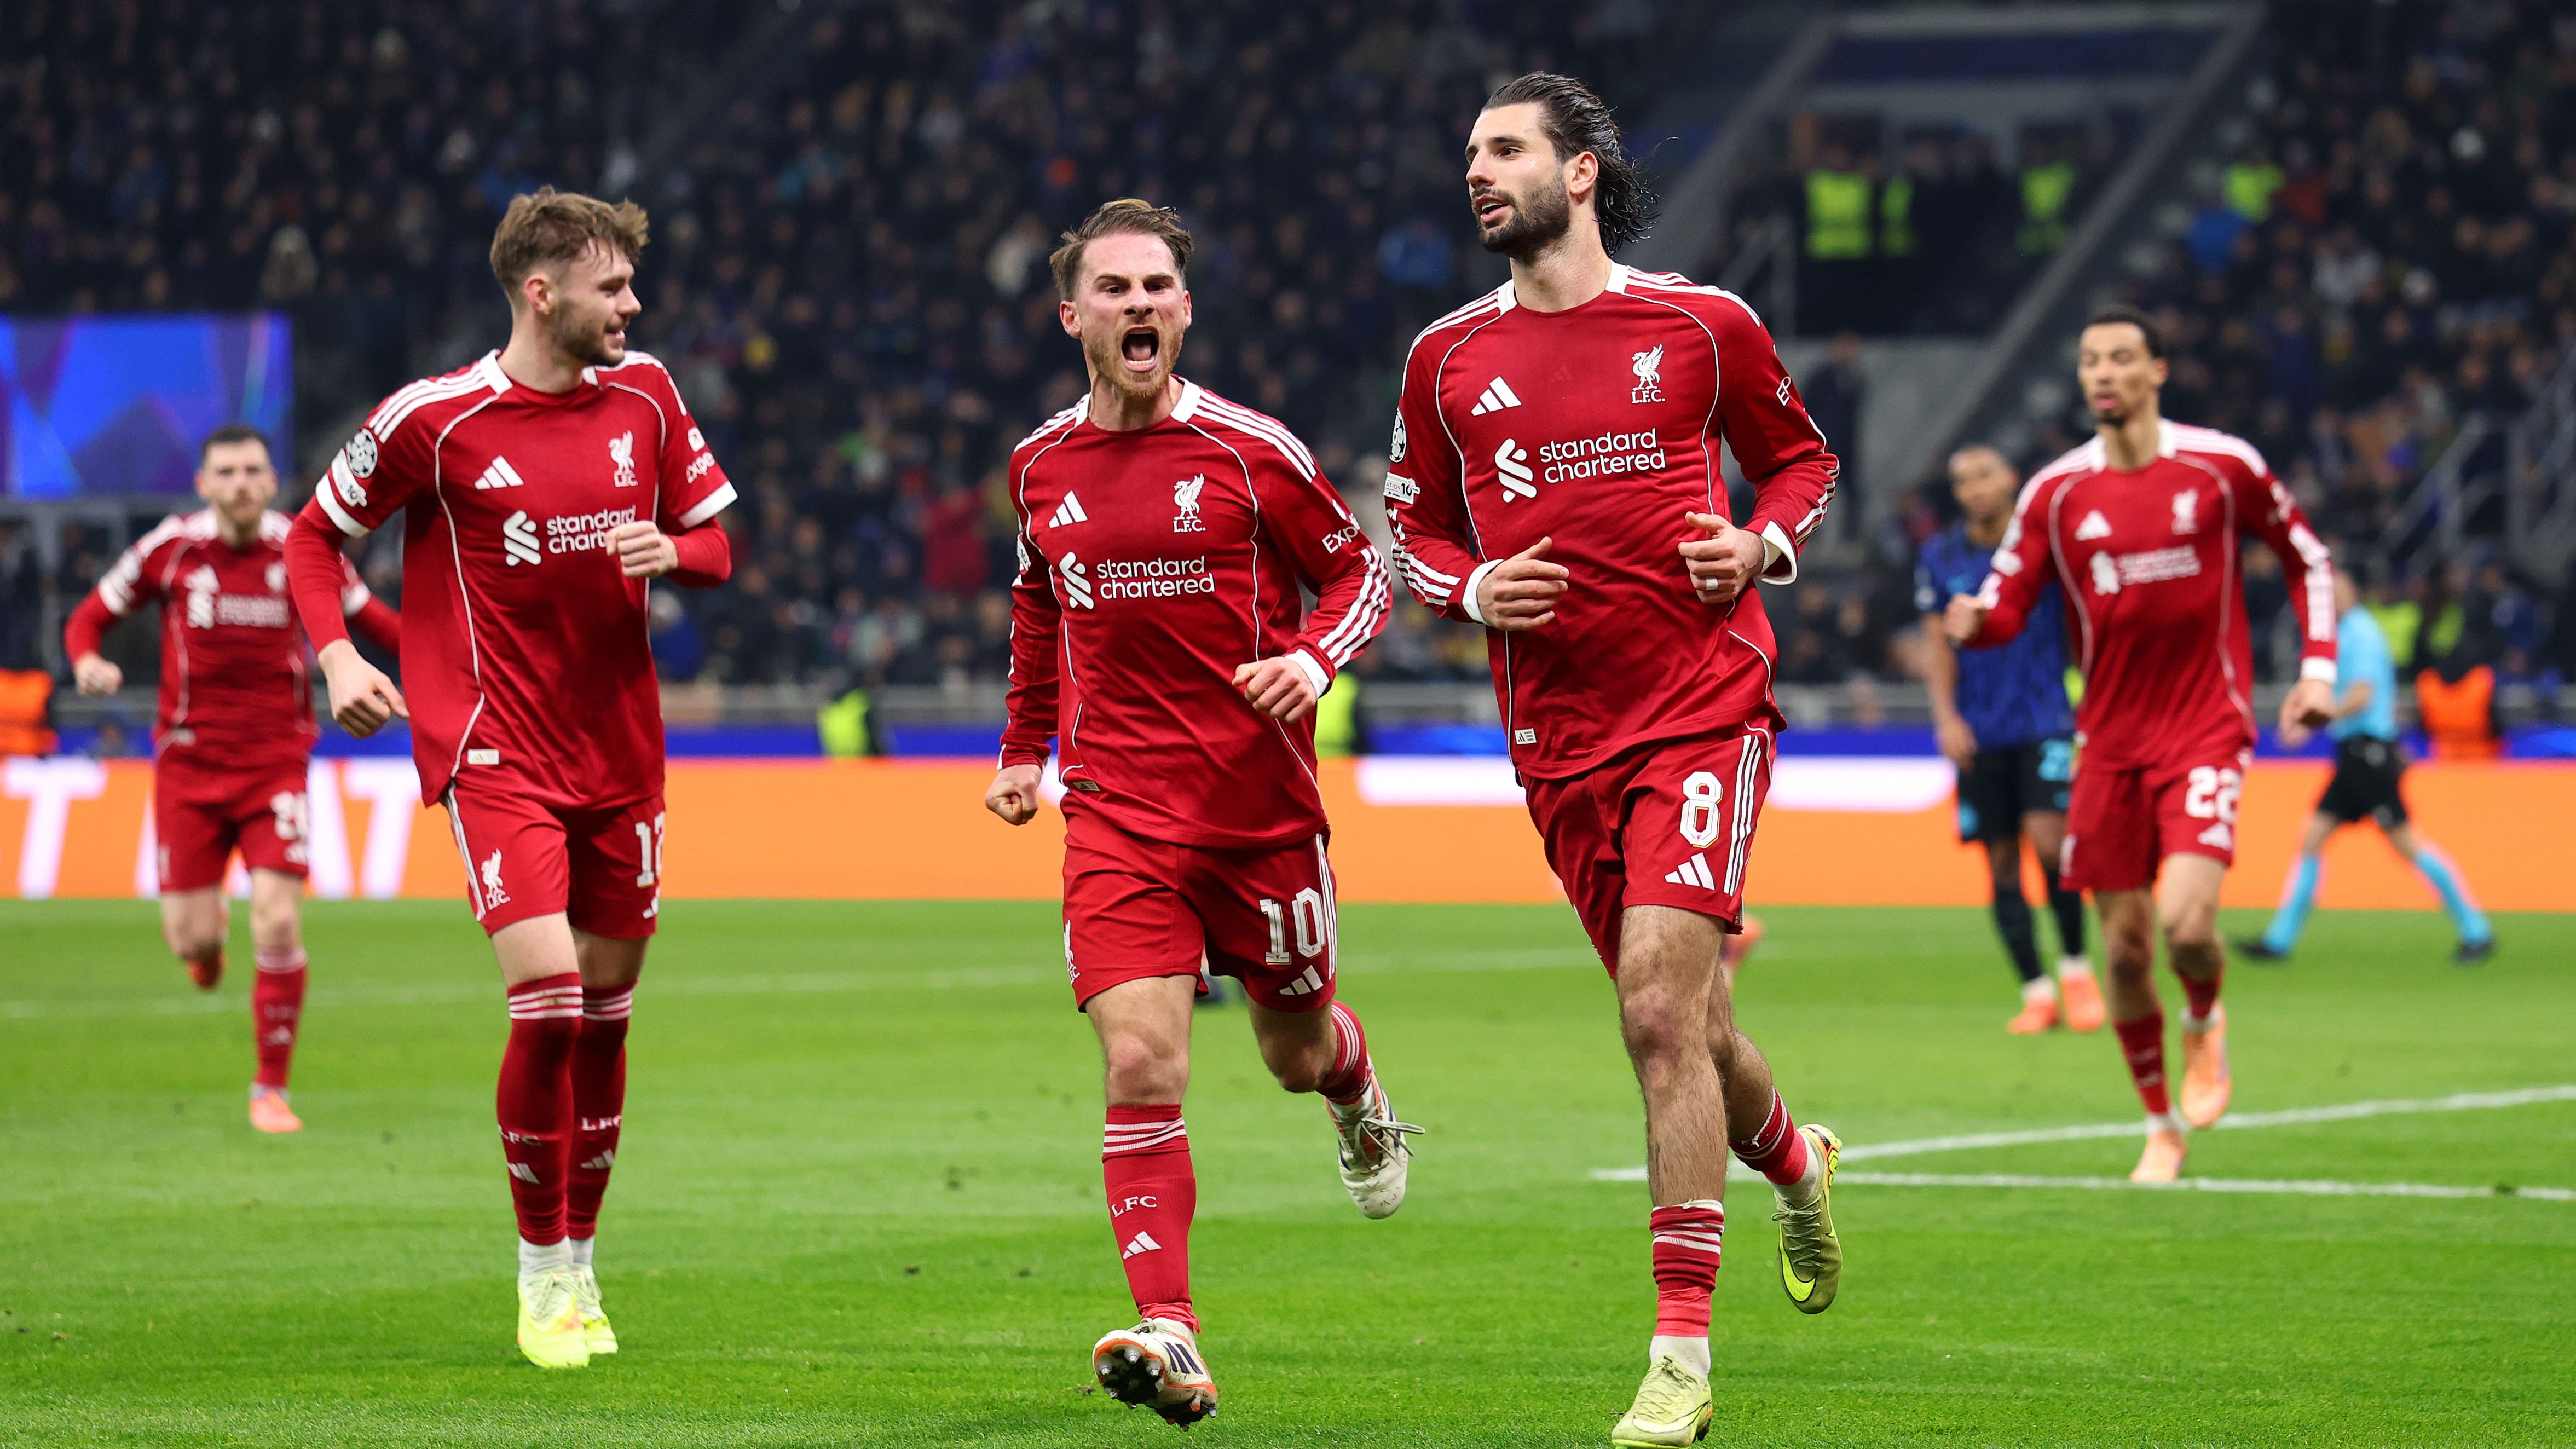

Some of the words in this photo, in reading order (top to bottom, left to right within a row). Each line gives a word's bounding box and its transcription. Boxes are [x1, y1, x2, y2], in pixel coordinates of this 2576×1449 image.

[1631, 390, 1666, 404] L.F.C.
[1539, 428, 1657, 463] standard
[1544, 448, 1666, 483] chartered
[1173, 519, 1206, 533] L.F.C.
[1096, 555, 1205, 579] standard
[1100, 573, 1215, 599] chartered
[2184, 765, 2240, 824] 22
[1679, 771, 1724, 849] 8
[1260, 887, 1326, 965] 10
[1111, 1195, 1158, 1219] LFC
